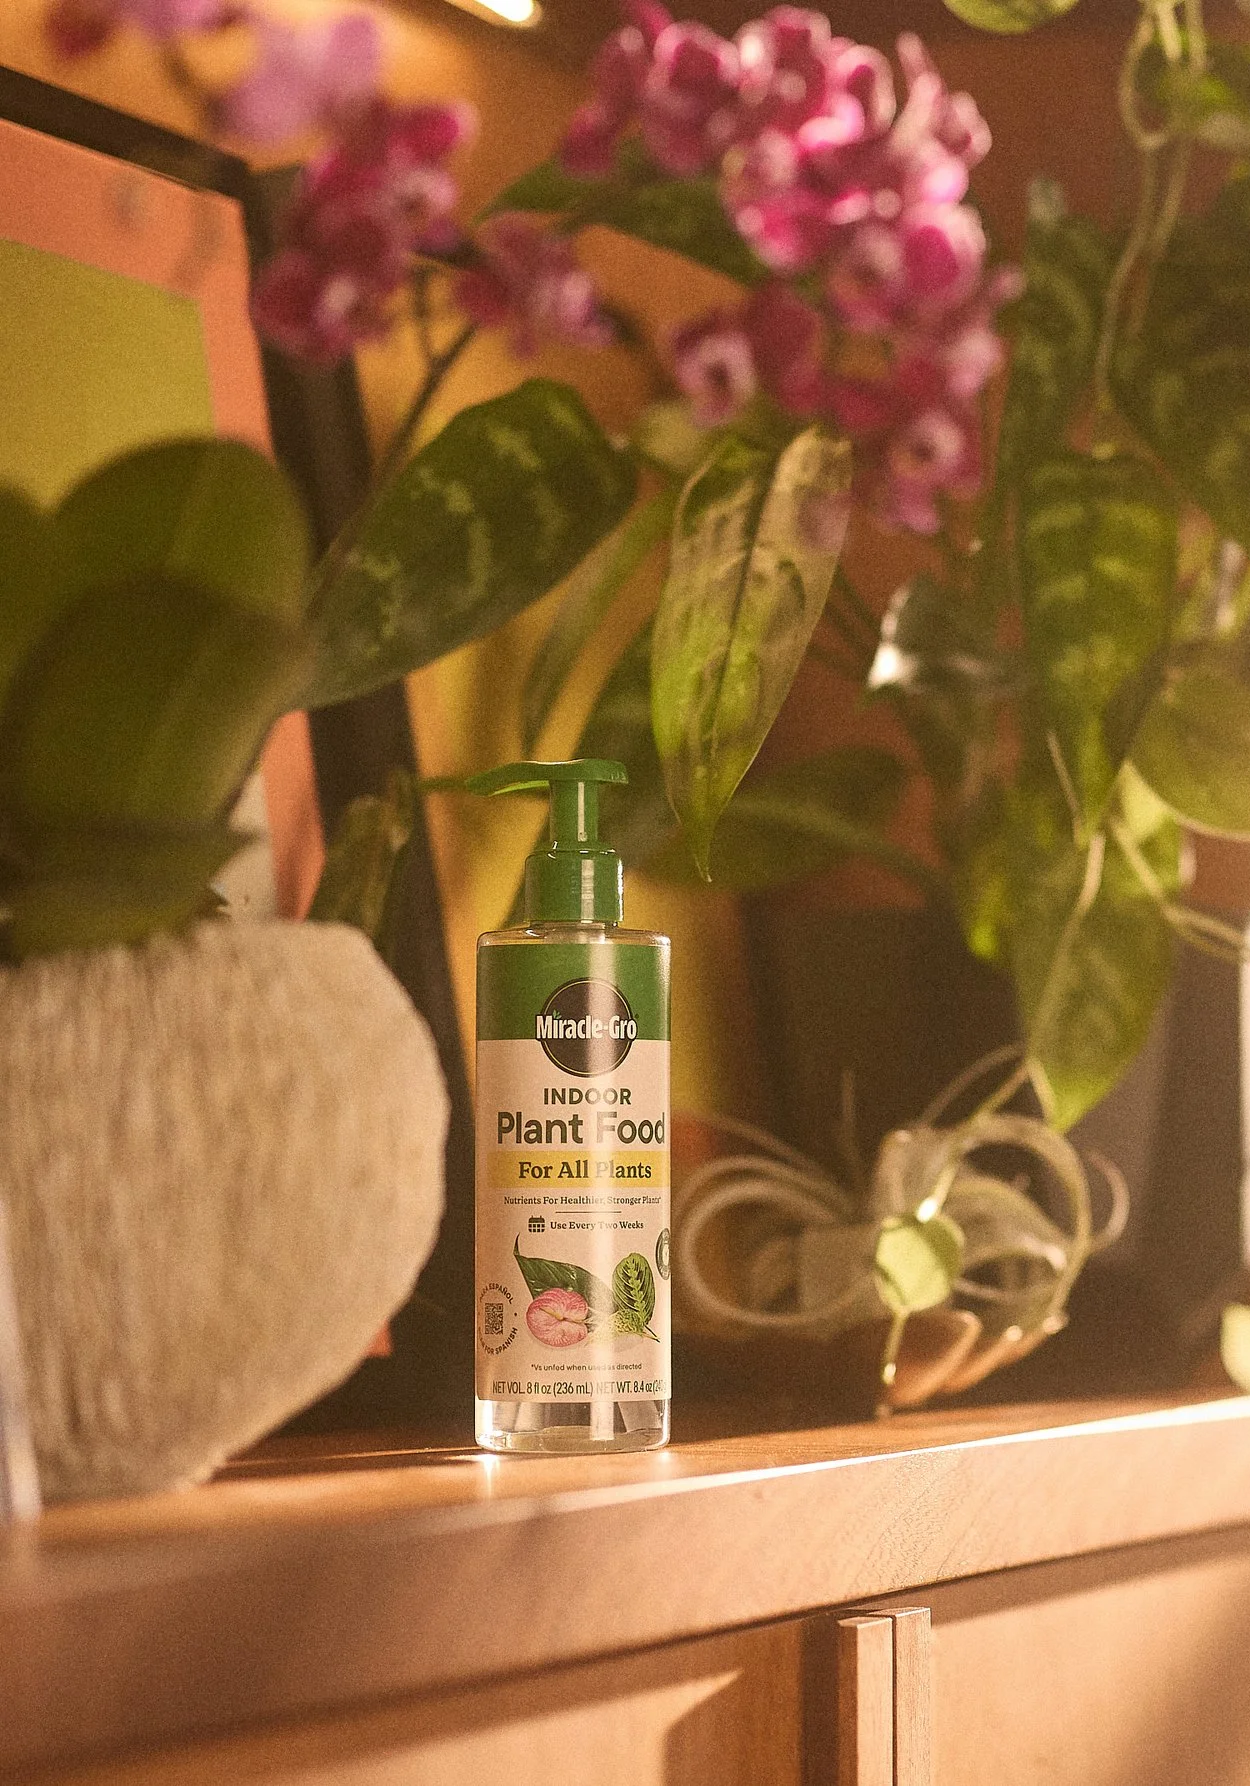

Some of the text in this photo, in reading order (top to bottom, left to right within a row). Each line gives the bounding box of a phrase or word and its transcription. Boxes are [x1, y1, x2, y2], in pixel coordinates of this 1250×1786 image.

[536, 1015, 638, 1040] Miracle-Gro
[543, 1088, 632, 1105] INDOOR
[497, 1111, 665, 1144] Plant Food
[518, 1159, 652, 1179] For All Plants
[503, 1195, 541, 1205] Nutrients
[543, 1196, 558, 1205] For
[607, 1195, 641, 1206] Stronger
[550, 1220, 644, 1231] Use Every Two Weeks
[494, 1326, 518, 1356] SPANISH
[543, 1363, 565, 1371] unfed
[566, 1363, 587, 1371] when
[616, 1362, 642, 1371] directed
[492, 1381, 506, 1395] NET
[526, 1381, 533, 1395] 8
[534, 1381, 540, 1395] fl
[541, 1384, 552, 1395] oz
[553, 1381, 574, 1398] (236
[575, 1381, 594, 1397] mL)
[596, 1381, 616, 1395] NET
[616, 1380, 632, 1394] WT.
[633, 1380, 645, 1393] 8.4
[645, 1382, 653, 1393] oz
